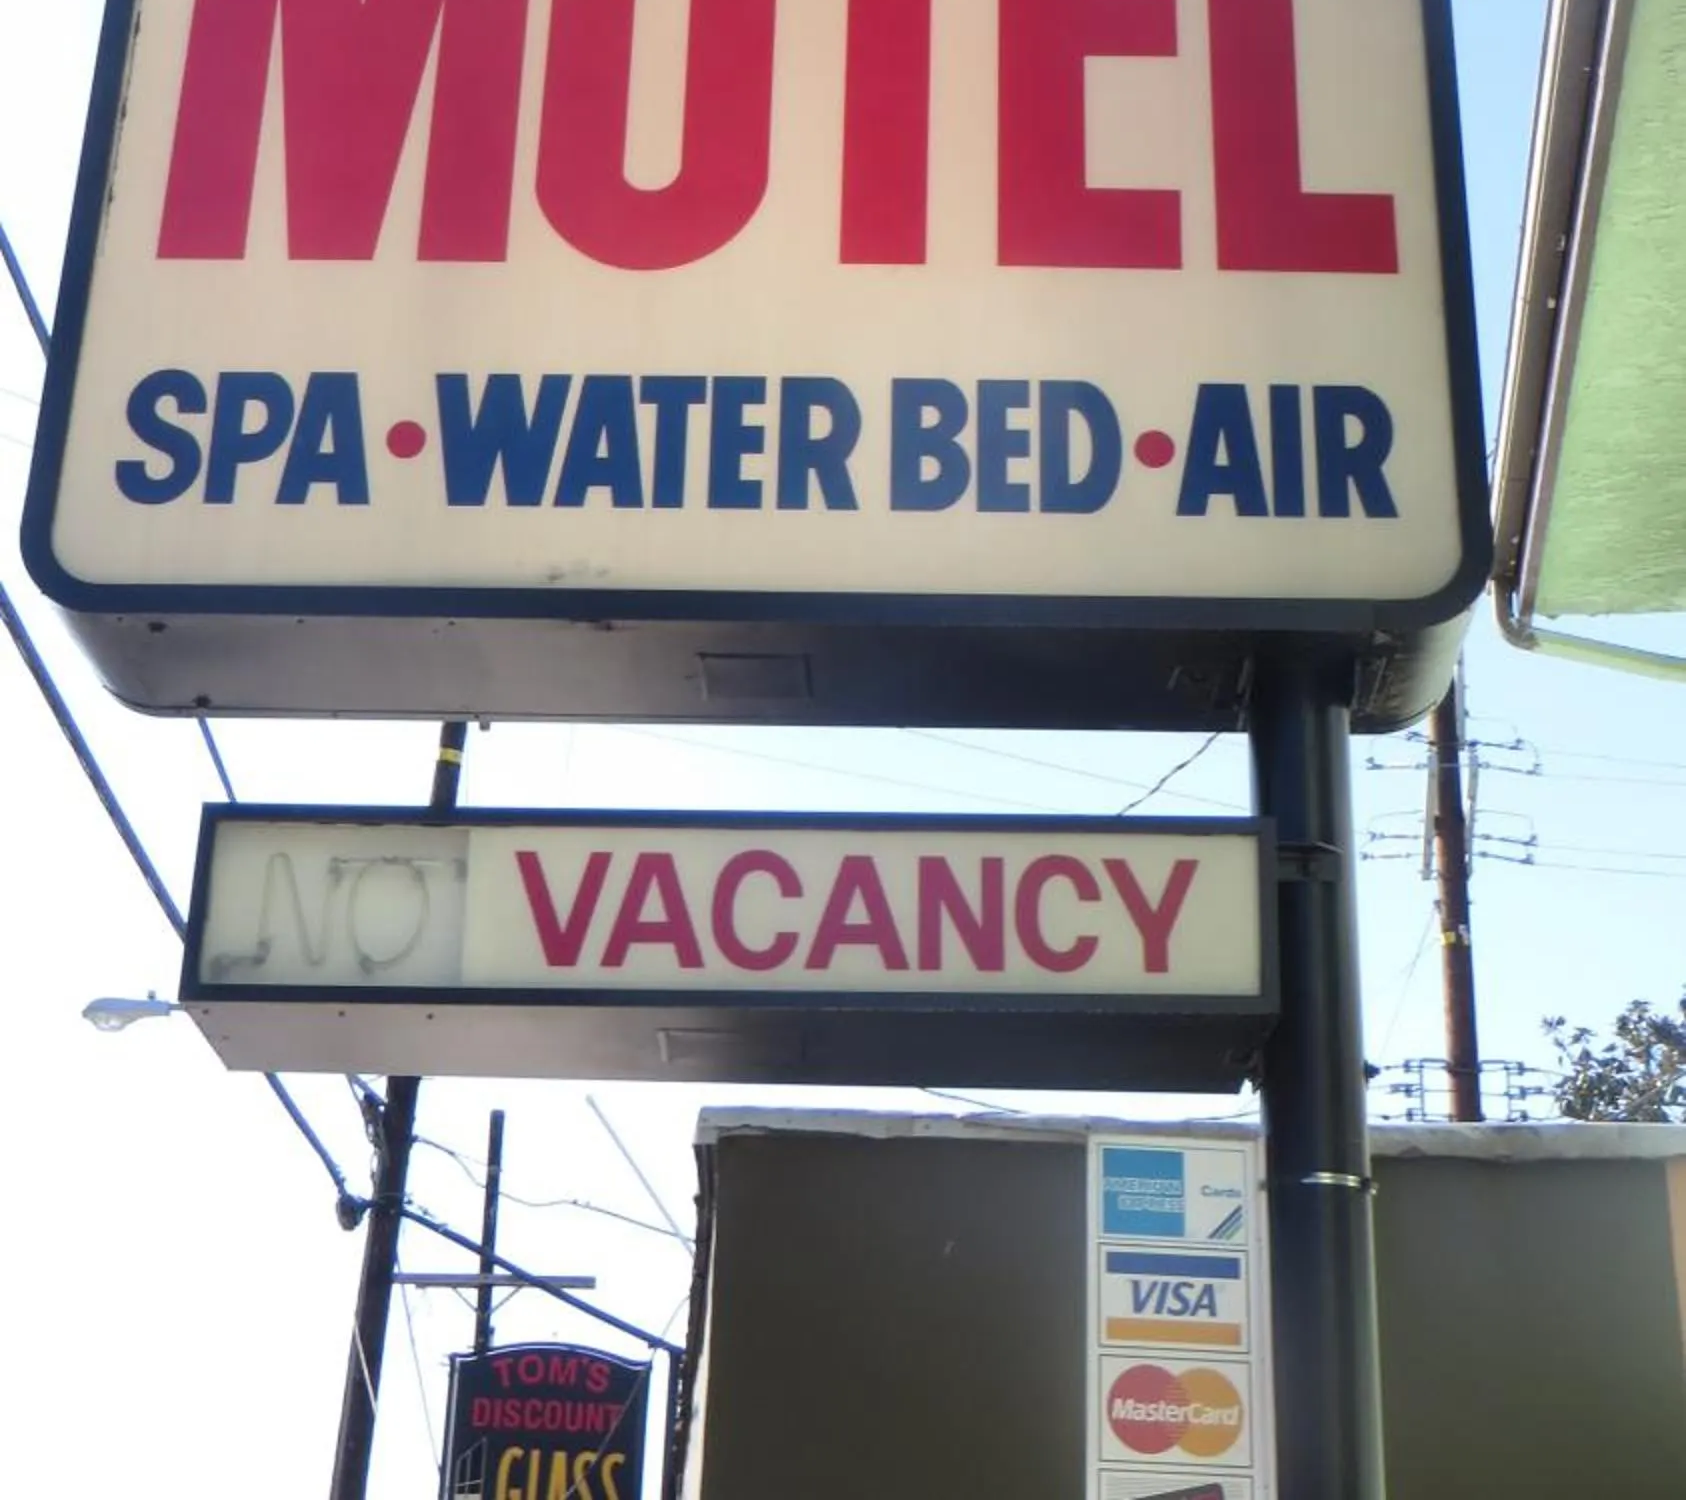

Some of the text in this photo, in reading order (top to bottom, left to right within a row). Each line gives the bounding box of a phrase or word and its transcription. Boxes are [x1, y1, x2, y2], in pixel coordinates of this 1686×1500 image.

[116, 370, 1398, 518] SPA WATER BED AIR
[519, 851, 1198, 973] VACANCY
[1130, 1279, 1218, 1318] VISA
[491, 1354, 611, 1394] TOM'S
[471, 1398, 625, 1433] DISCOUNT
[1111, 1397, 1240, 1426] MasterCard
